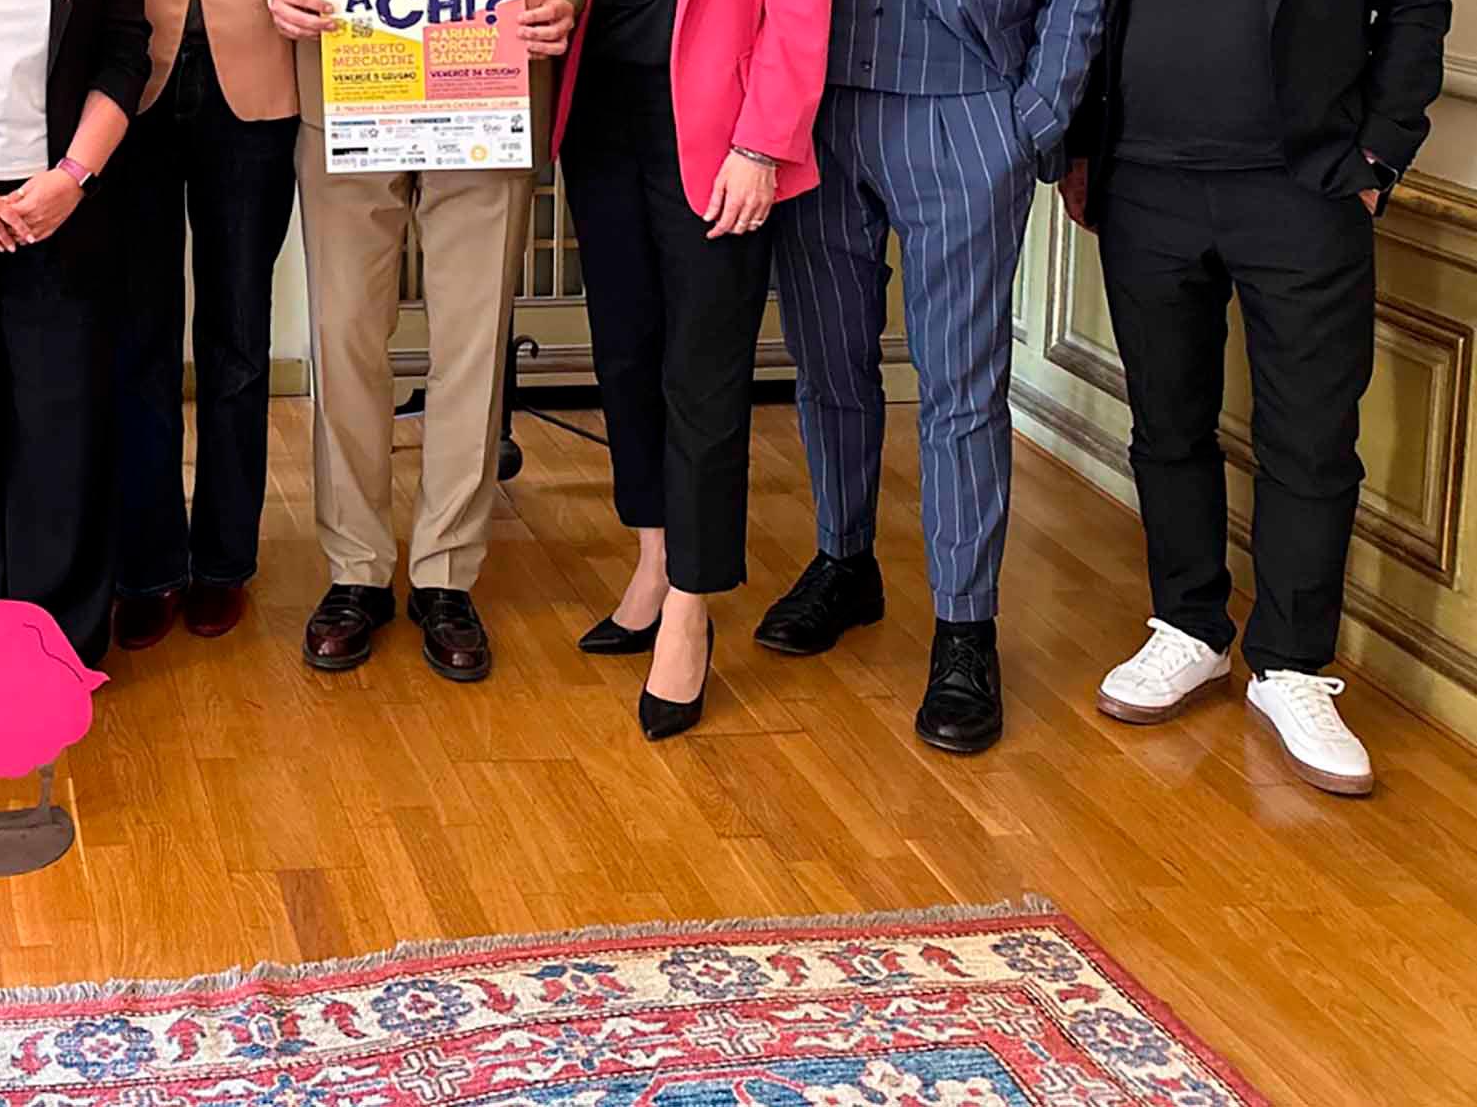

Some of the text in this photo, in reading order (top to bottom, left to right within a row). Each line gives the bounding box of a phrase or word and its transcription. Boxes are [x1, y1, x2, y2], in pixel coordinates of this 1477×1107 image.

[440, 27, 500, 40] ARIANNA
[342, 43, 406, 55] ROBERTO
[428, 38, 496, 52] PORCELLI
[332, 53, 415, 68] MERCADINI
[430, 51, 494, 65] SAFONOV
